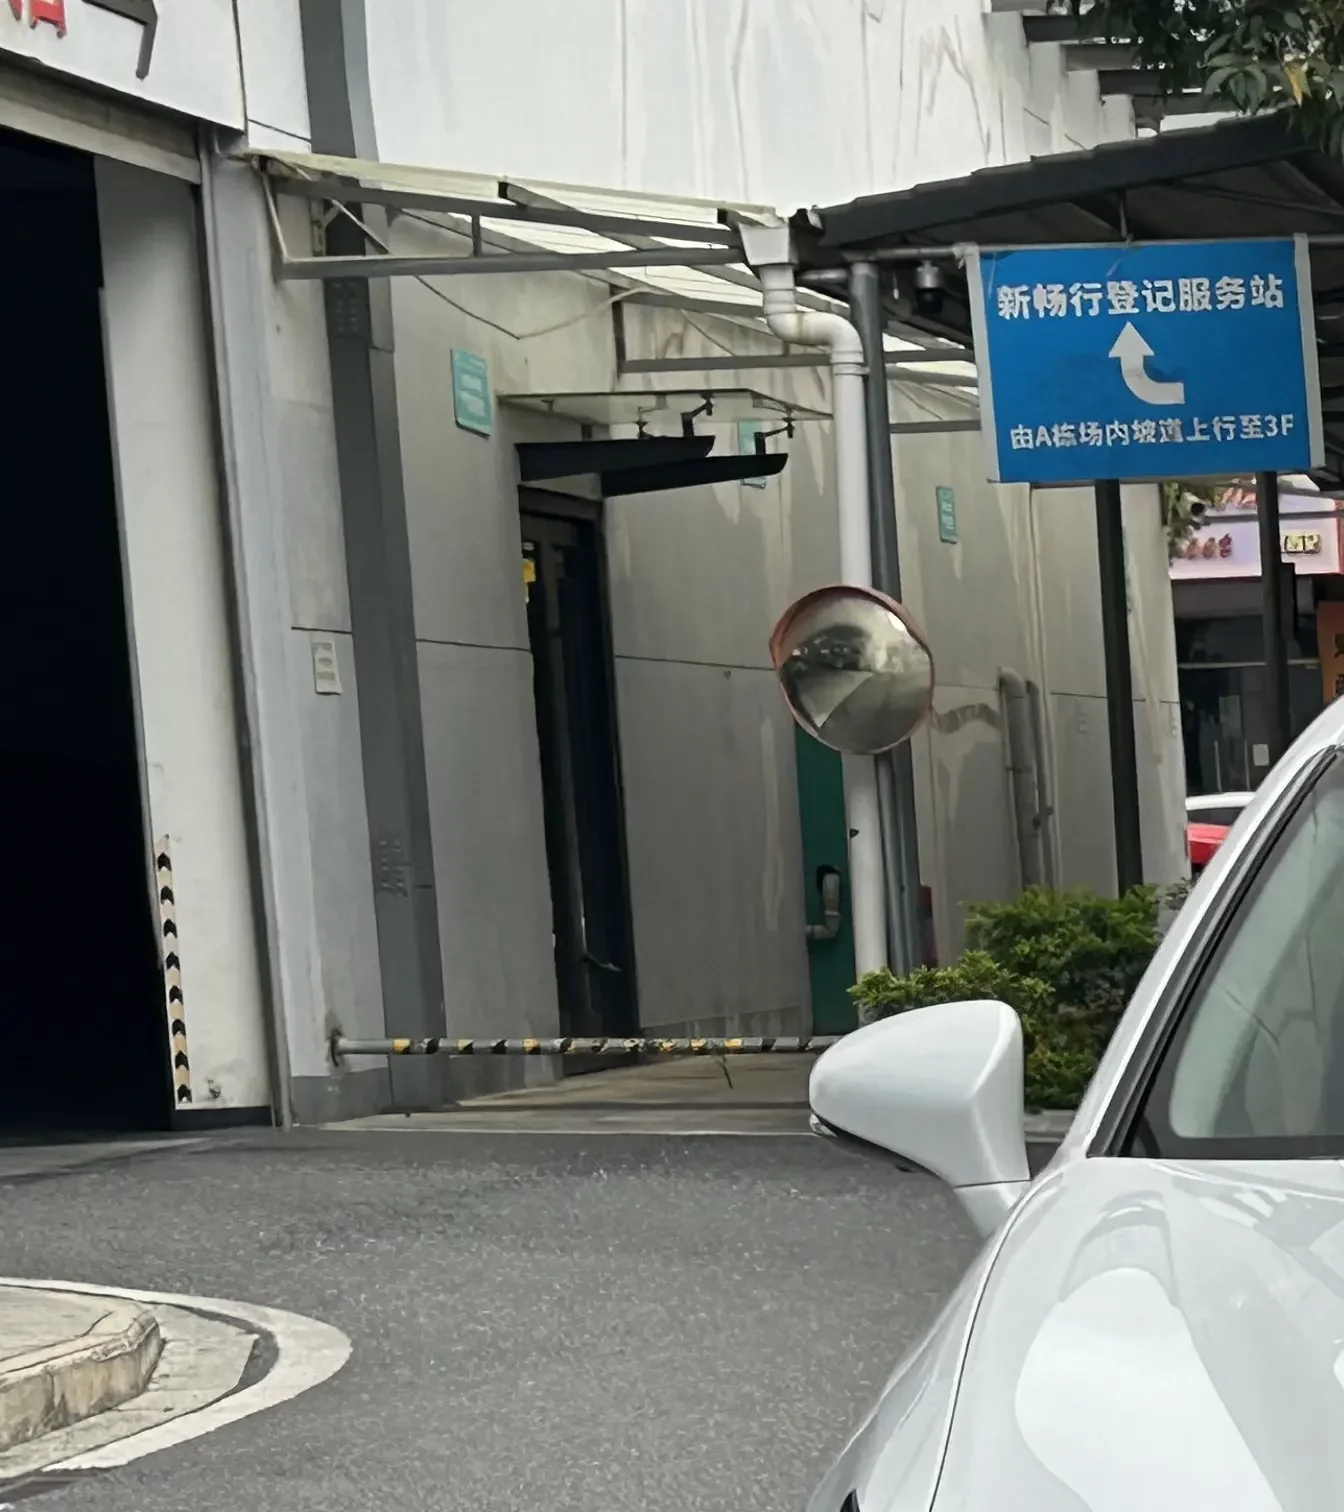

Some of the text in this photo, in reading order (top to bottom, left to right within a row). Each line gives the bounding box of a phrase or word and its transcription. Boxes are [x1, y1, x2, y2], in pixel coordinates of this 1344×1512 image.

[996, 273, 1284, 320] 新畅行登记服务站
